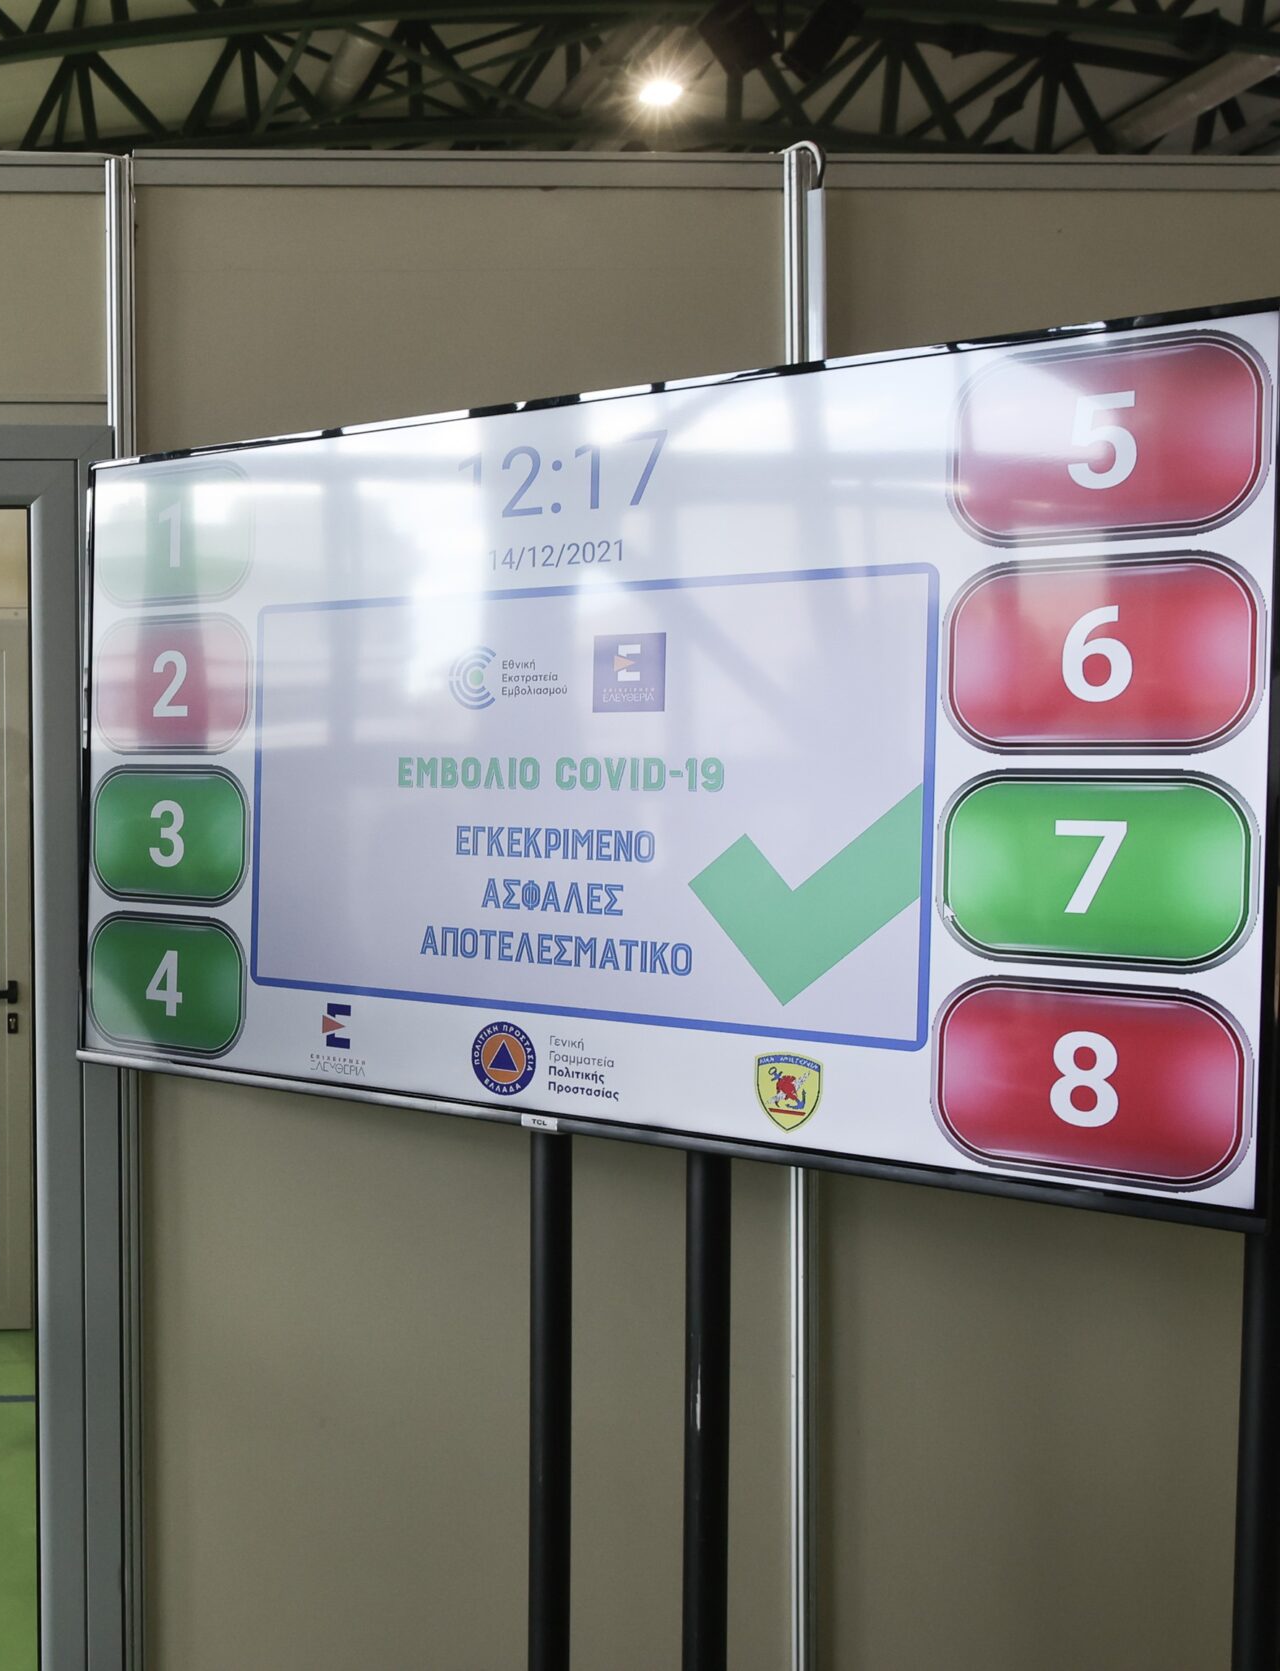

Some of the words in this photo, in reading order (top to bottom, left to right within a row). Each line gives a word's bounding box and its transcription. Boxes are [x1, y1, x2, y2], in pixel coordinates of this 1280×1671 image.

[1067, 389, 1138, 491] 5
[458, 429, 668, 518] 12:17
[158, 501, 182, 568] 1
[489, 539, 623, 571] 14/12/2021
[502, 659, 536, 670] Εθνική
[1061, 604, 1133, 704] 6
[152, 649, 189, 718] 2
[501, 684, 568, 697] Εμβολιασμού
[502, 672, 558, 684] Εκστρατεία
[397, 757, 541, 789] ΕΜΒΟΛΙΟ
[555, 757, 725, 792] COVID-19
[149, 799, 185, 868] 3
[456, 825, 656, 864] ΕΓΚΕΚΡΙΜΕΝΟ
[1054, 819, 1129, 915] 7
[481, 877, 624, 916] ΑΣΦΑΛΕΣ
[420, 925, 693, 976] ΑΠΟΤΕΛΕΣΜΑΤΙΚΟ
[145, 949, 183, 1017] 4
[474, 1025, 499, 1065] ΠΟΛΙΤΙΚΗ
[502, 1024, 535, 1071] ΠΡΟΣΤΑΣΙΑ
[548, 1050, 615, 1069] Γραμματεία
[549, 1035, 585, 1051] Γενική
[483, 1078, 522, 1093] ΕΛΛΑΔΑ
[548, 1066, 605, 1085] Πολιτικής
[548, 1081, 619, 1101] Προστασίας
[1049, 1030, 1120, 1129] 8
[531, 1118, 548, 1126] TCL
